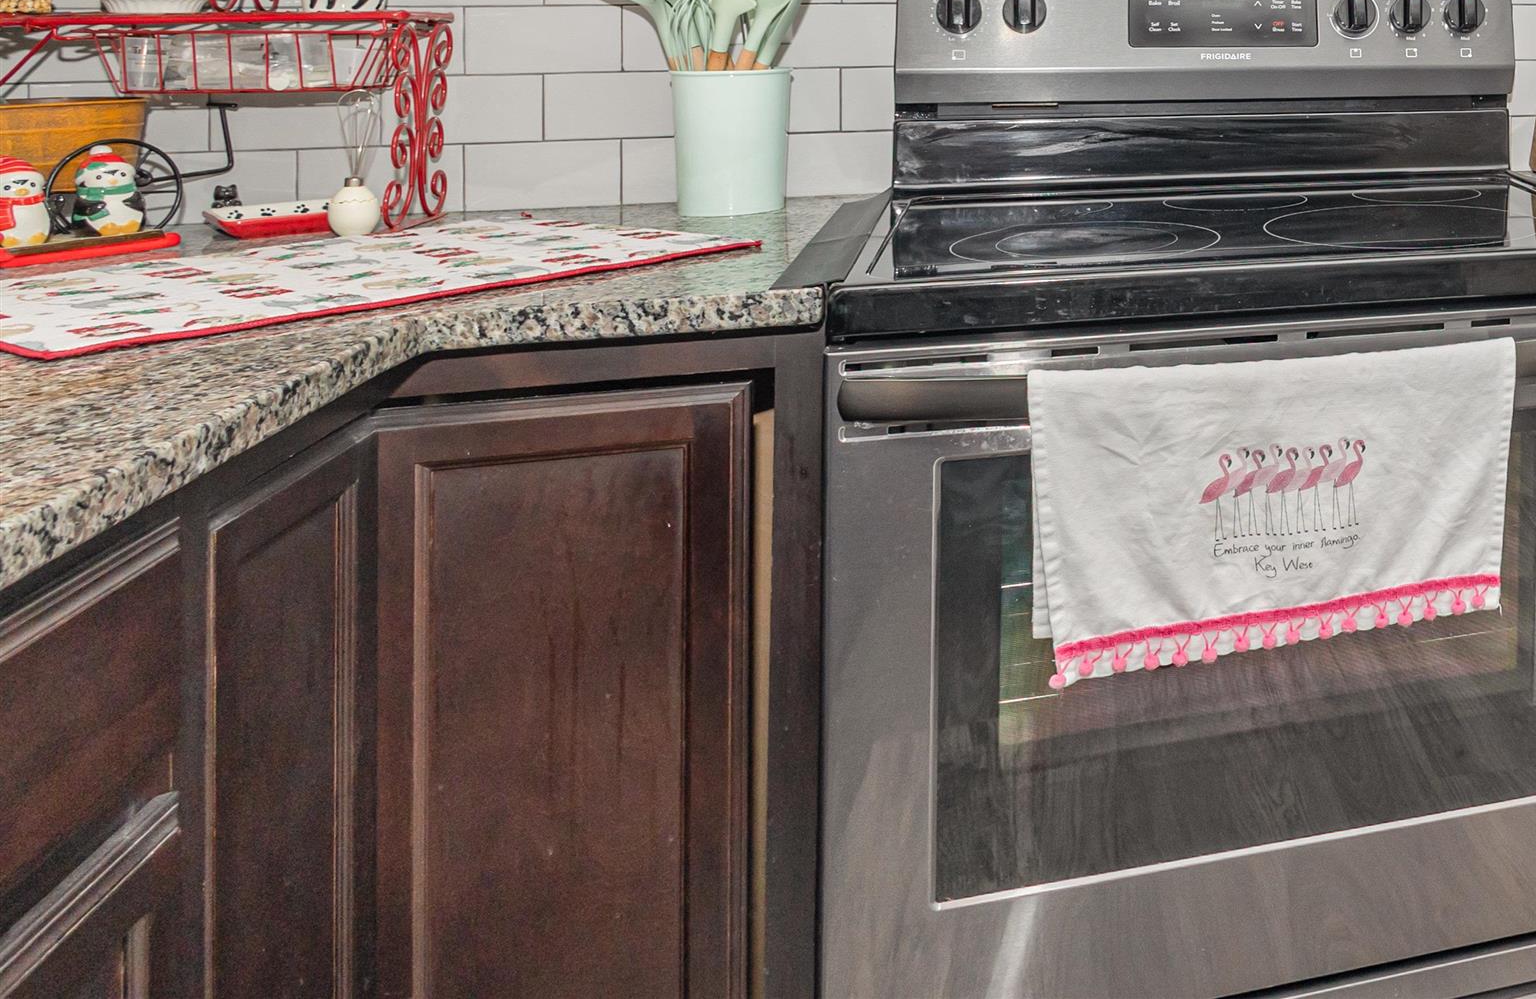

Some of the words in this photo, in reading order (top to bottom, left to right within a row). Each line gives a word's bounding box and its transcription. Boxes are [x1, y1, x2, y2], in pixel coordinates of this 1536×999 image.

[1200, 53, 1252, 61] FRIGIDAIRE
[1213, 543, 1259, 558] Embrace
[1264, 541, 1286, 557] your
[1292, 540, 1315, 550] inner
[1253, 555, 1278, 578] Key
[1282, 556, 1313, 572] West
